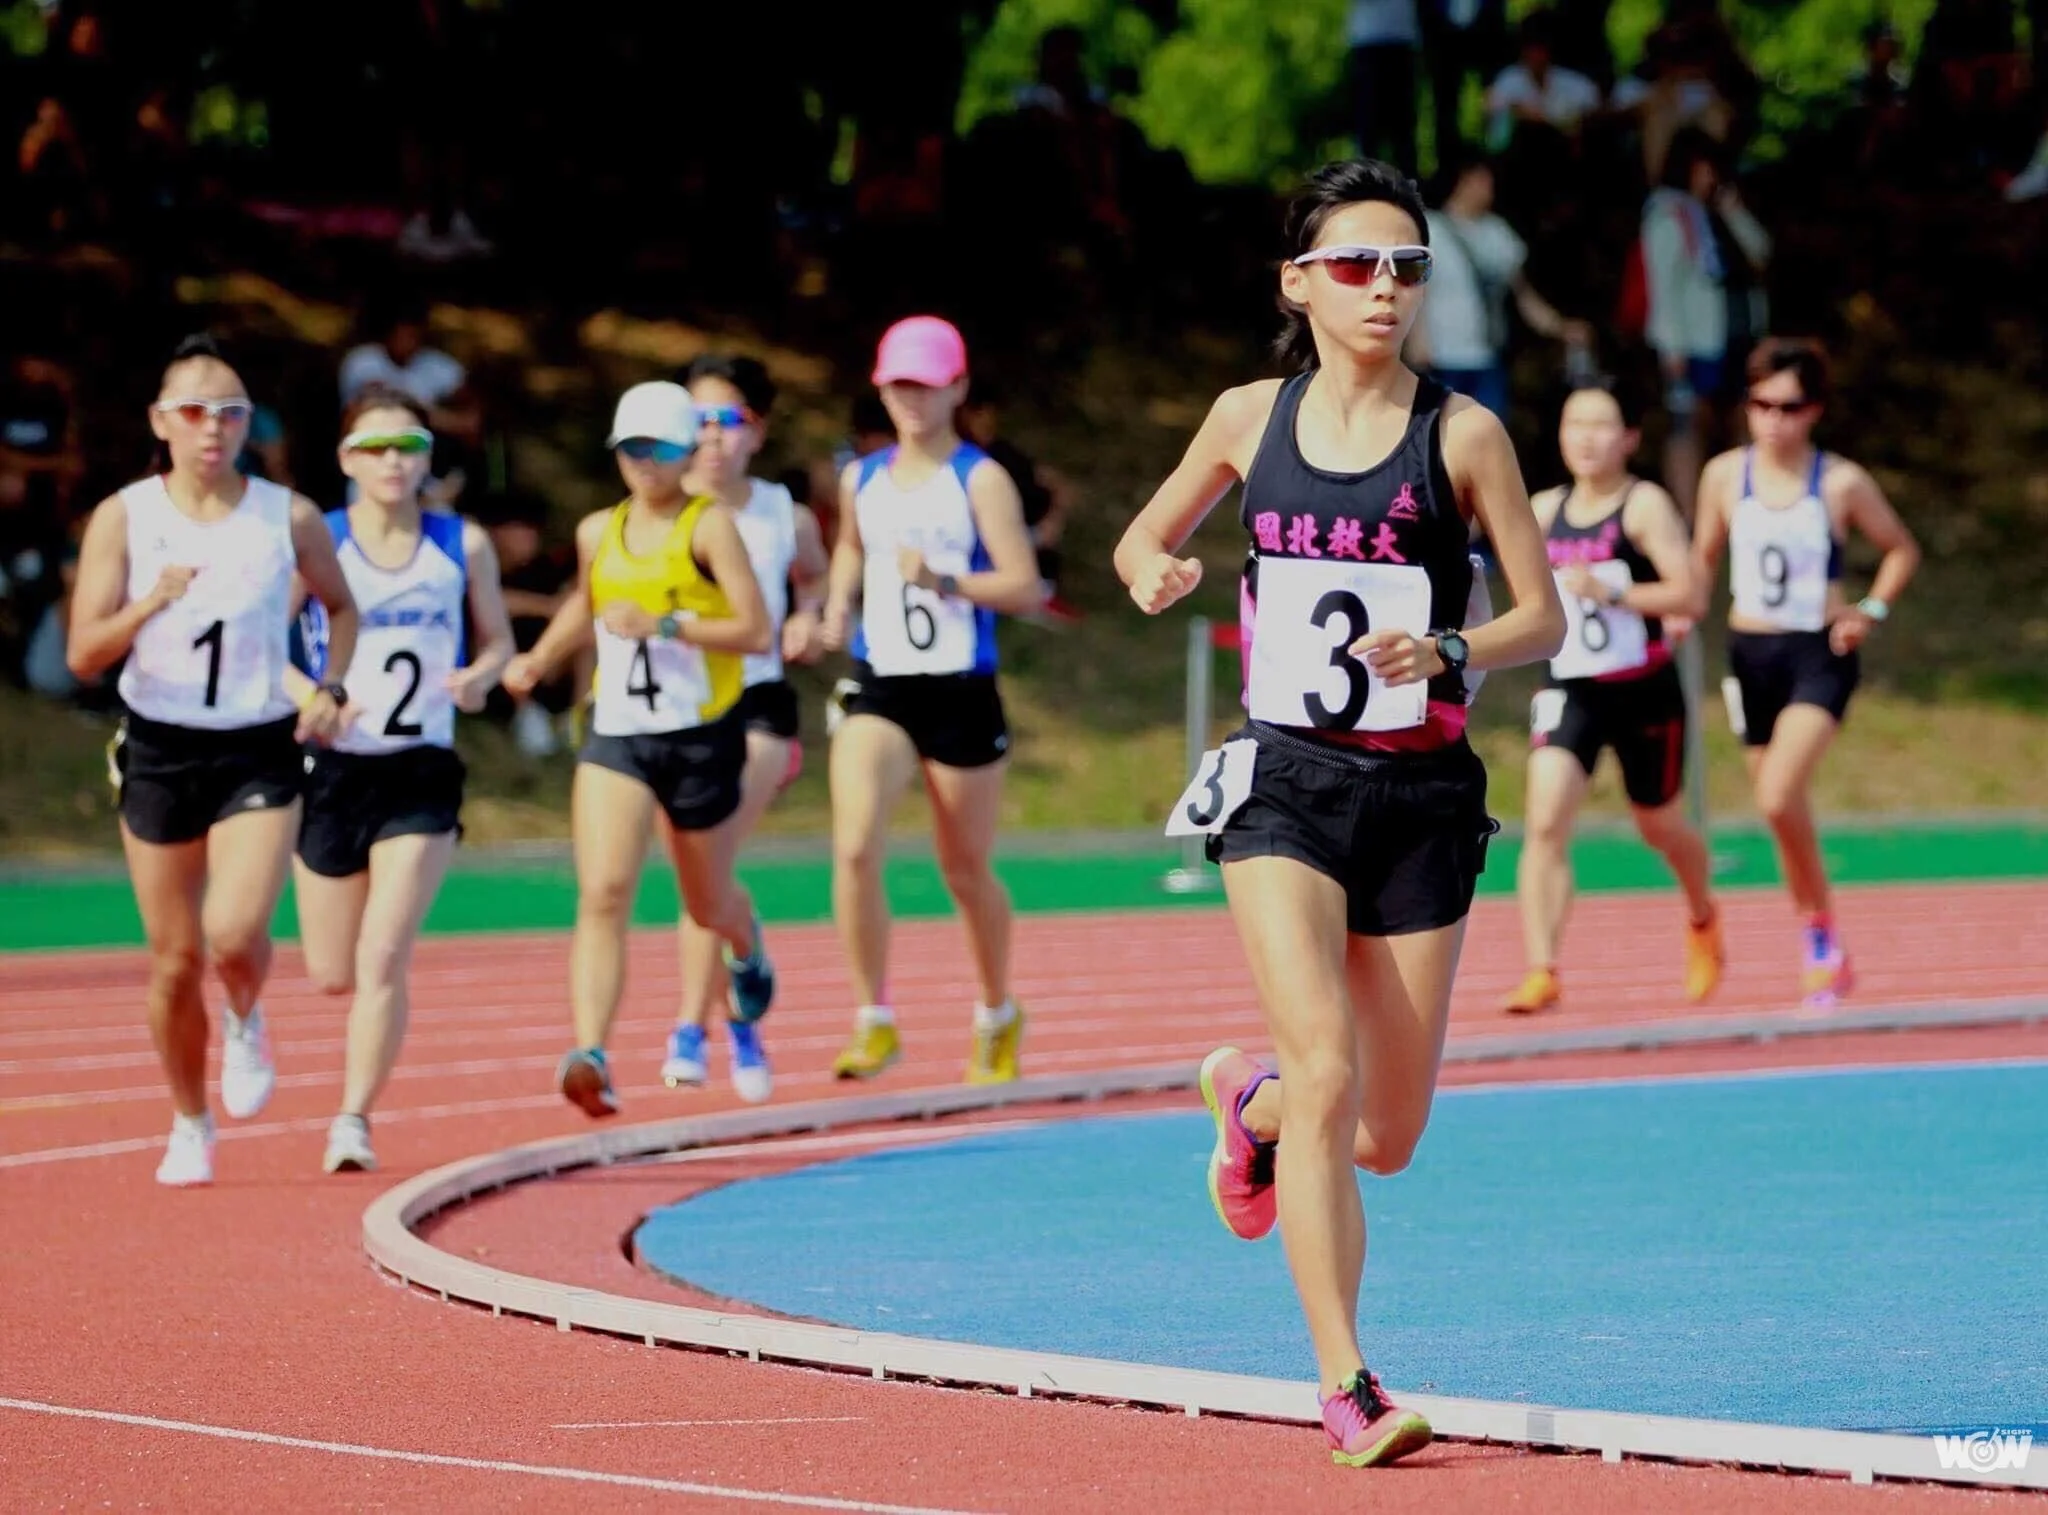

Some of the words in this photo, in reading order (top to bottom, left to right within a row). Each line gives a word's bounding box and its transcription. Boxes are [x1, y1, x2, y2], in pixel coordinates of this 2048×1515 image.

[1759, 544, 1790, 608] 9
[902, 582, 936, 650] 6
[192, 619, 224, 707] 1
[383, 650, 423, 736] 2
[626, 637, 661, 712] 4
[1303, 590, 1371, 731] 3
[1187, 750, 1227, 826] 3
